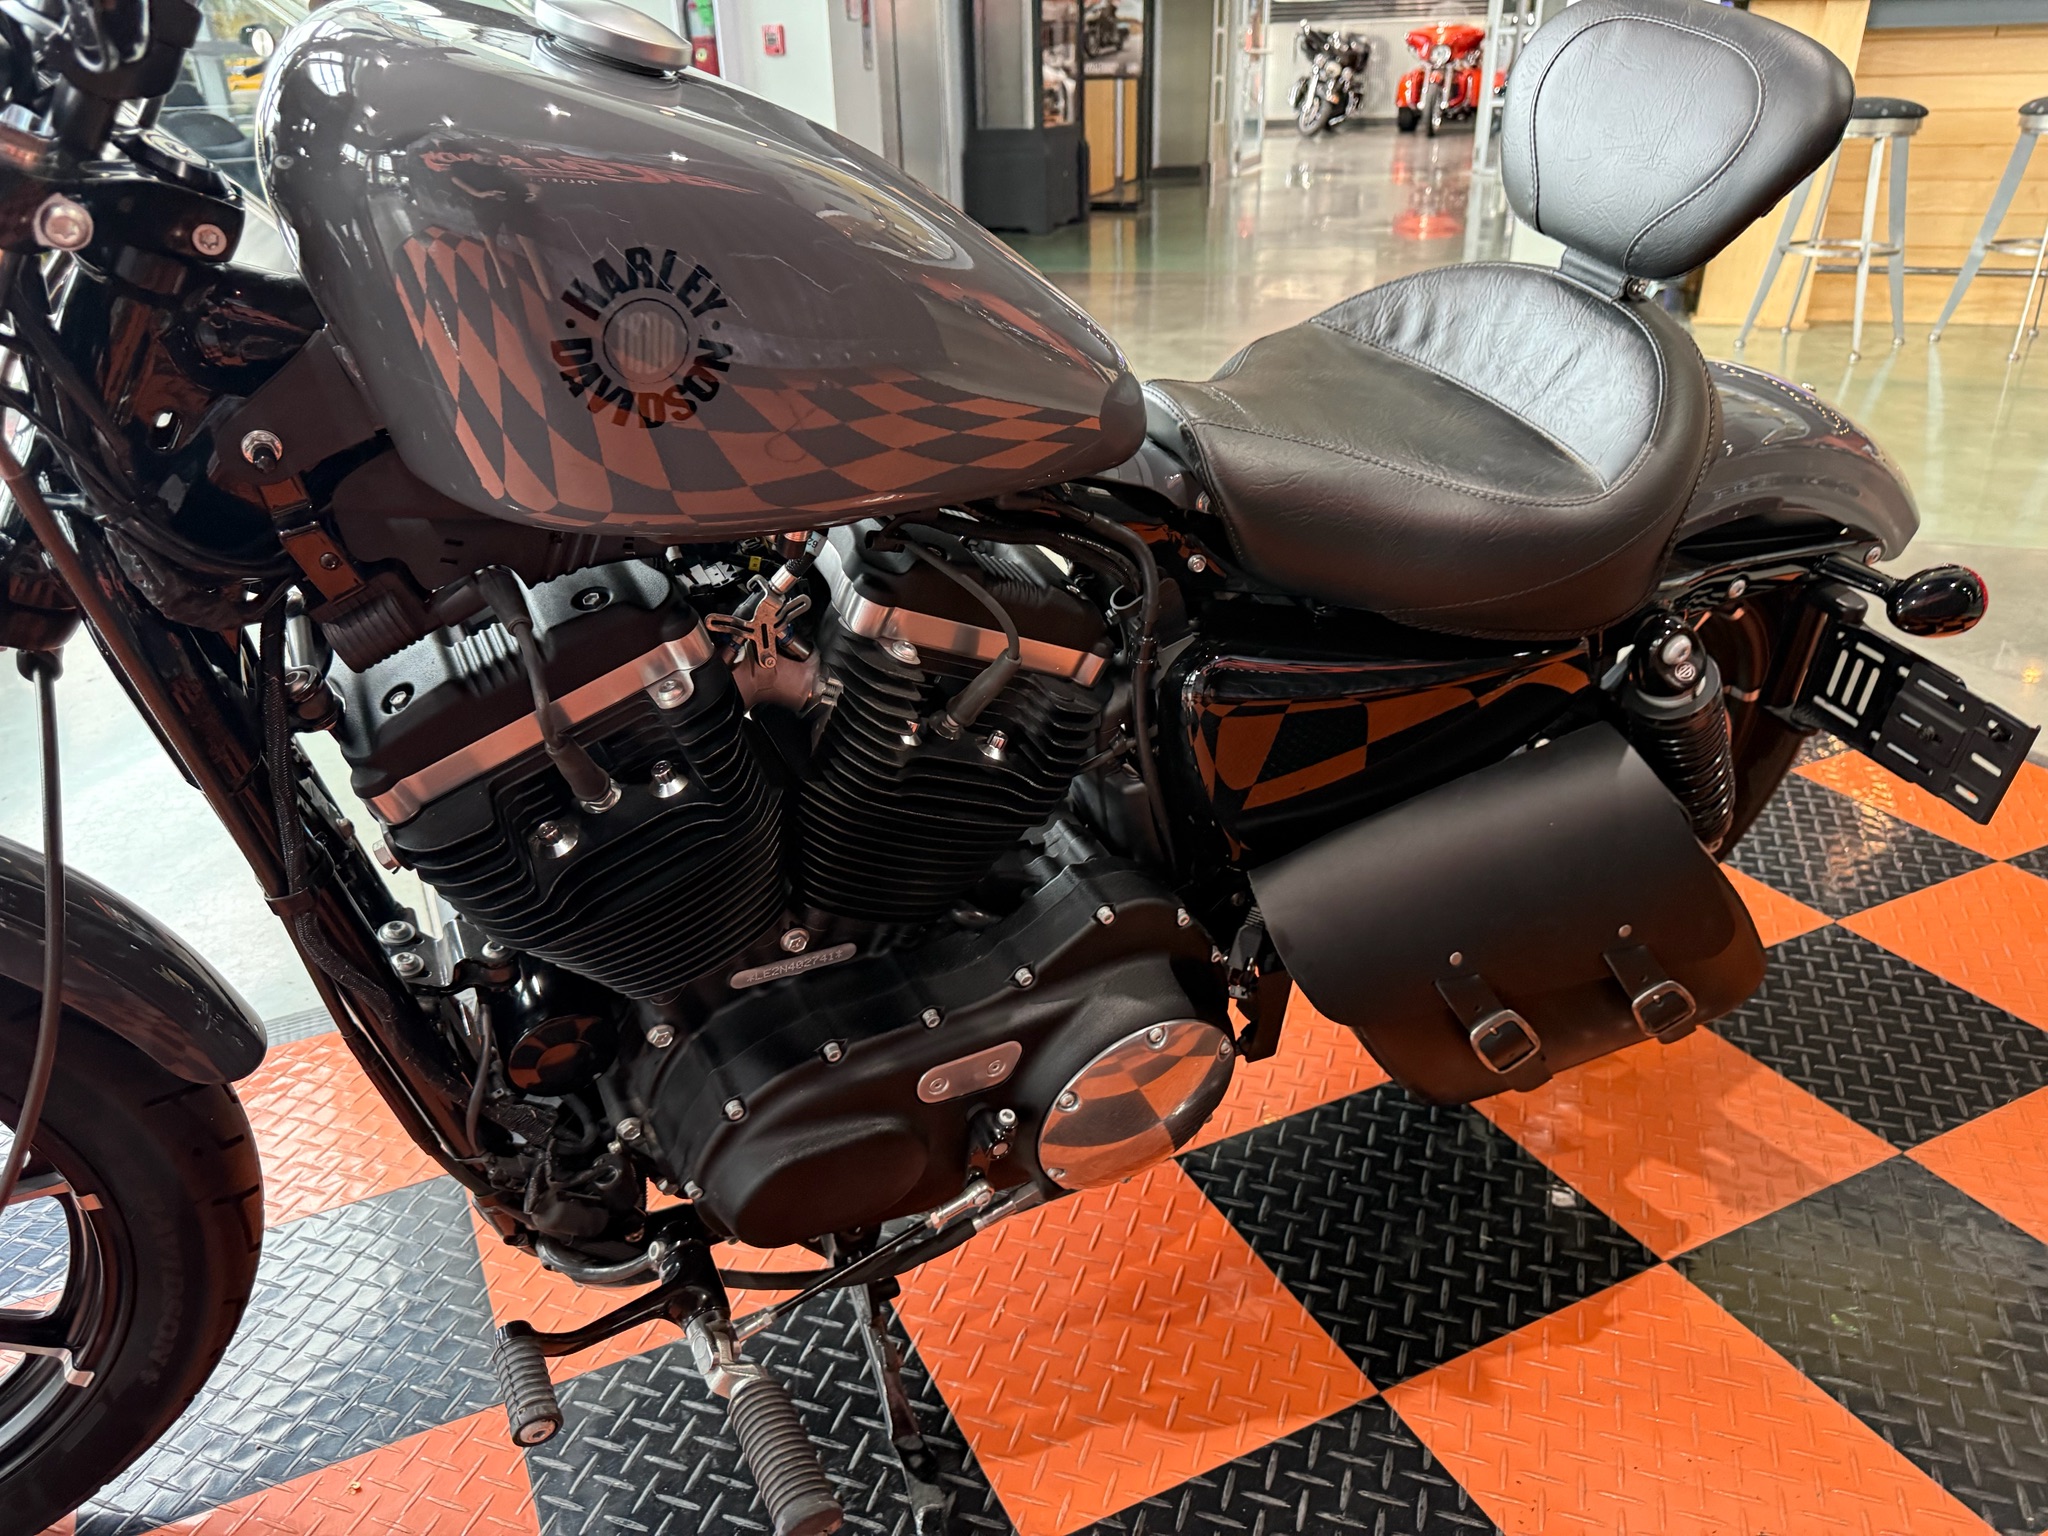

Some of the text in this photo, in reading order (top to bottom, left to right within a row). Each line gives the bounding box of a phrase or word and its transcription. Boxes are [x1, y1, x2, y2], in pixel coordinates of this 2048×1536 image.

[561, 246, 728, 321] HARLEY
[551, 338, 733, 428] DAVIDSON
[139, 1195, 185, 1367] DAVIDSON
